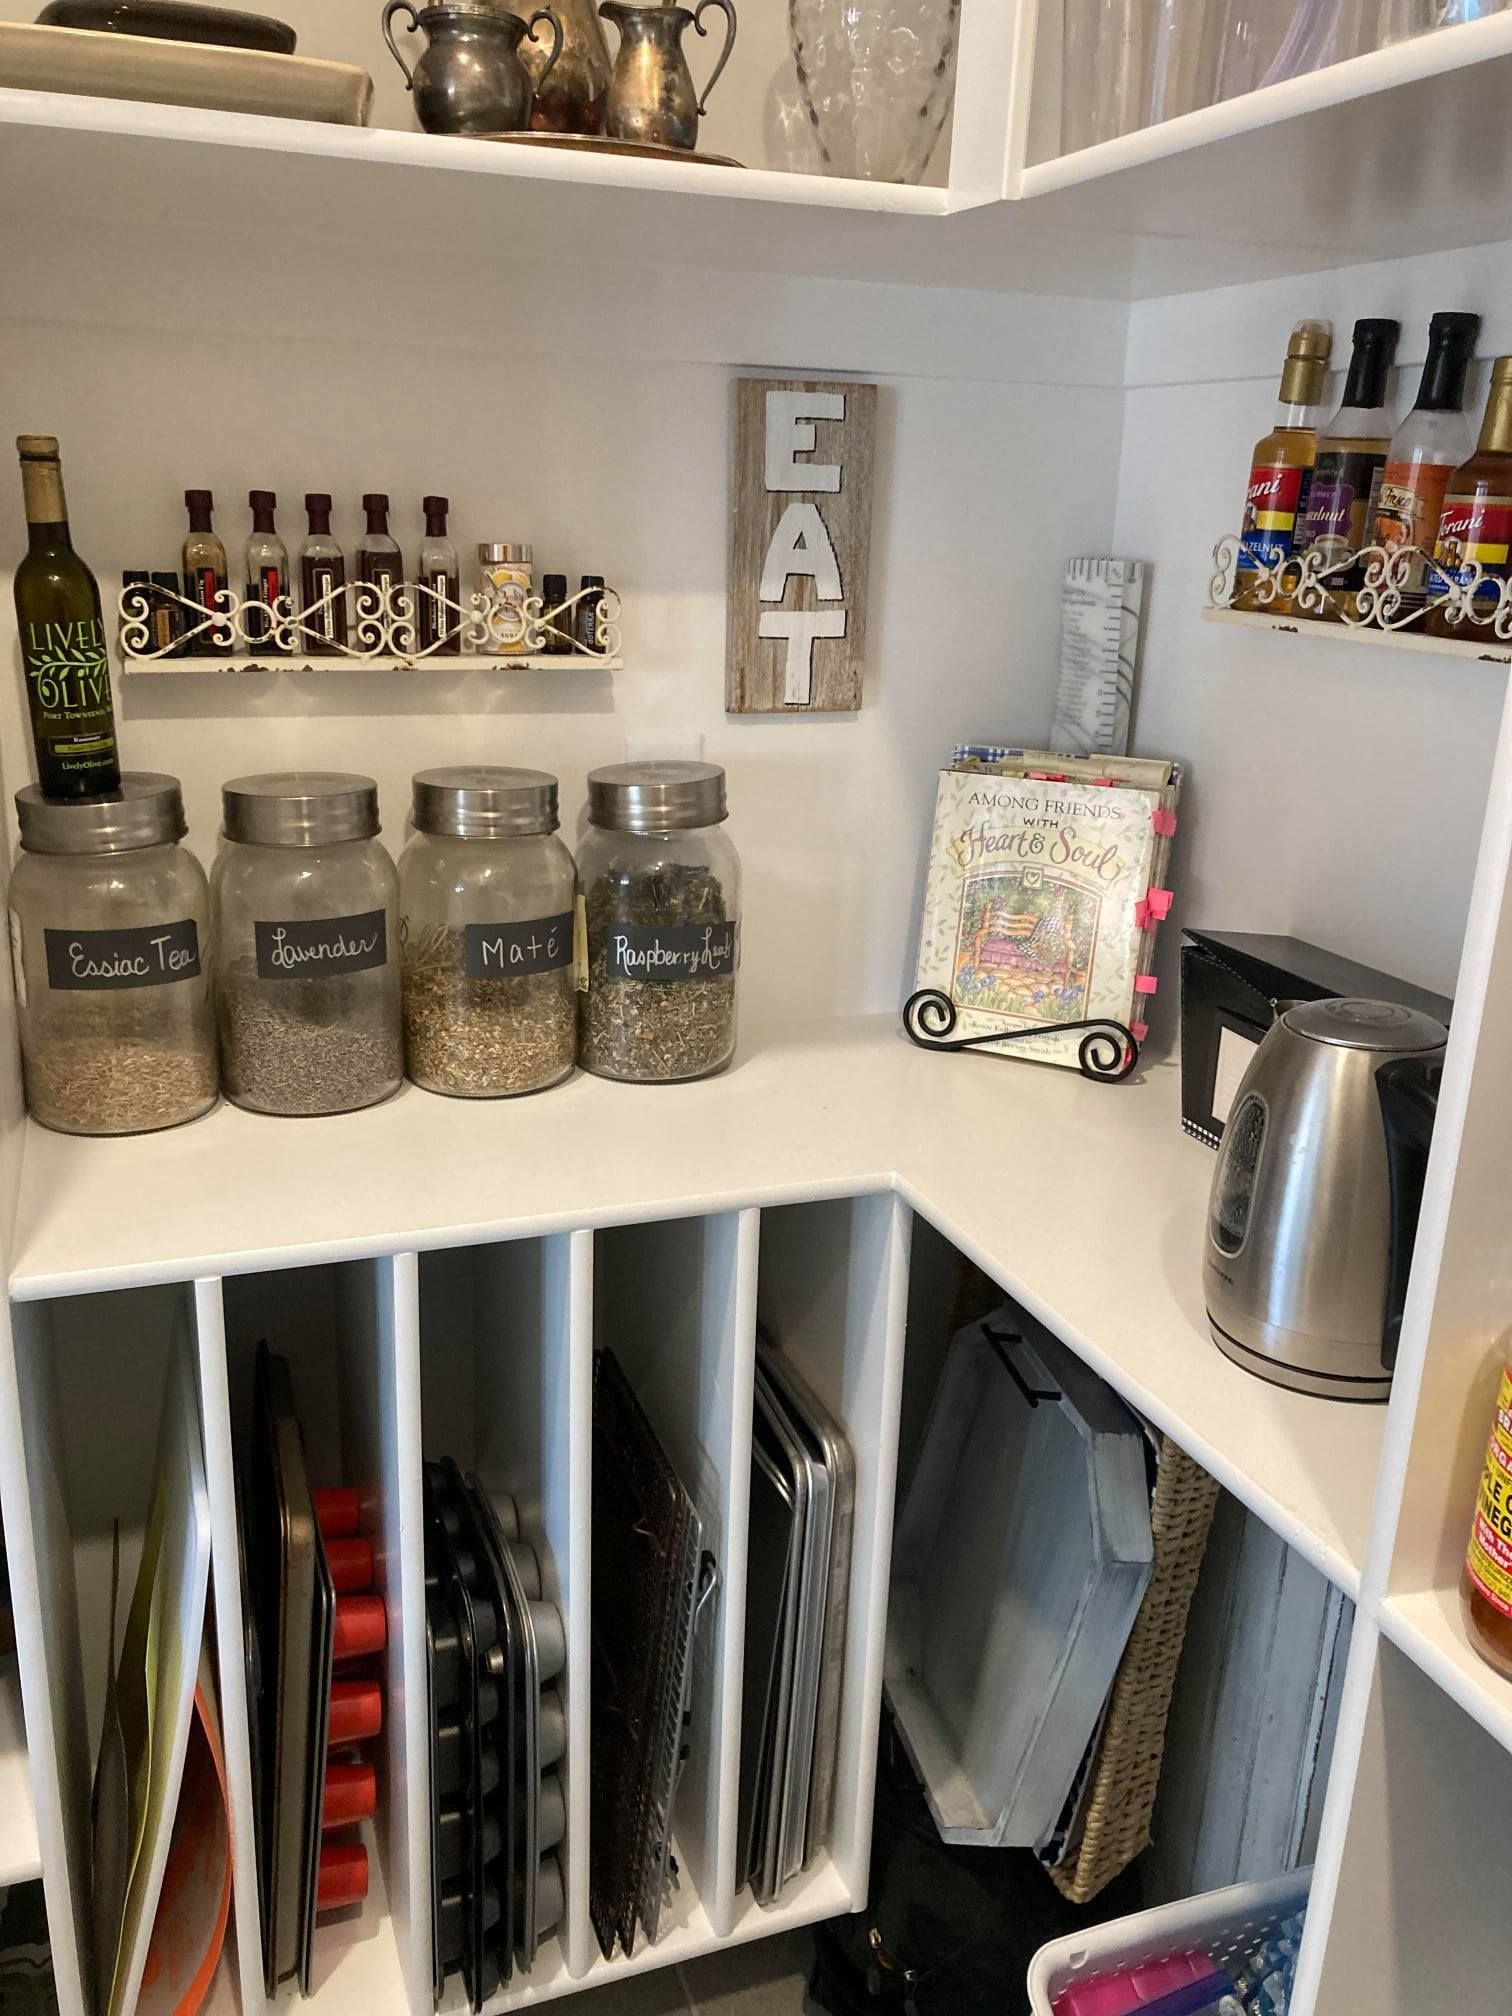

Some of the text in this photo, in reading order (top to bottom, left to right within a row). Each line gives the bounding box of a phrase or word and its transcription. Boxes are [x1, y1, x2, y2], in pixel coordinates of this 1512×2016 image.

[1440, 509, 1486, 536] Torani
[758, 390, 847, 705] EAT
[968, 791, 1122, 819] AMONG FRIENDS
[1023, 816, 1059, 829] WITH
[958, 820, 1126, 881] Heart & Soul
[69, 935, 197, 977] Essiac Tea
[272, 927, 378, 968] Lavender
[614, 934, 700, 976] Raspberry
